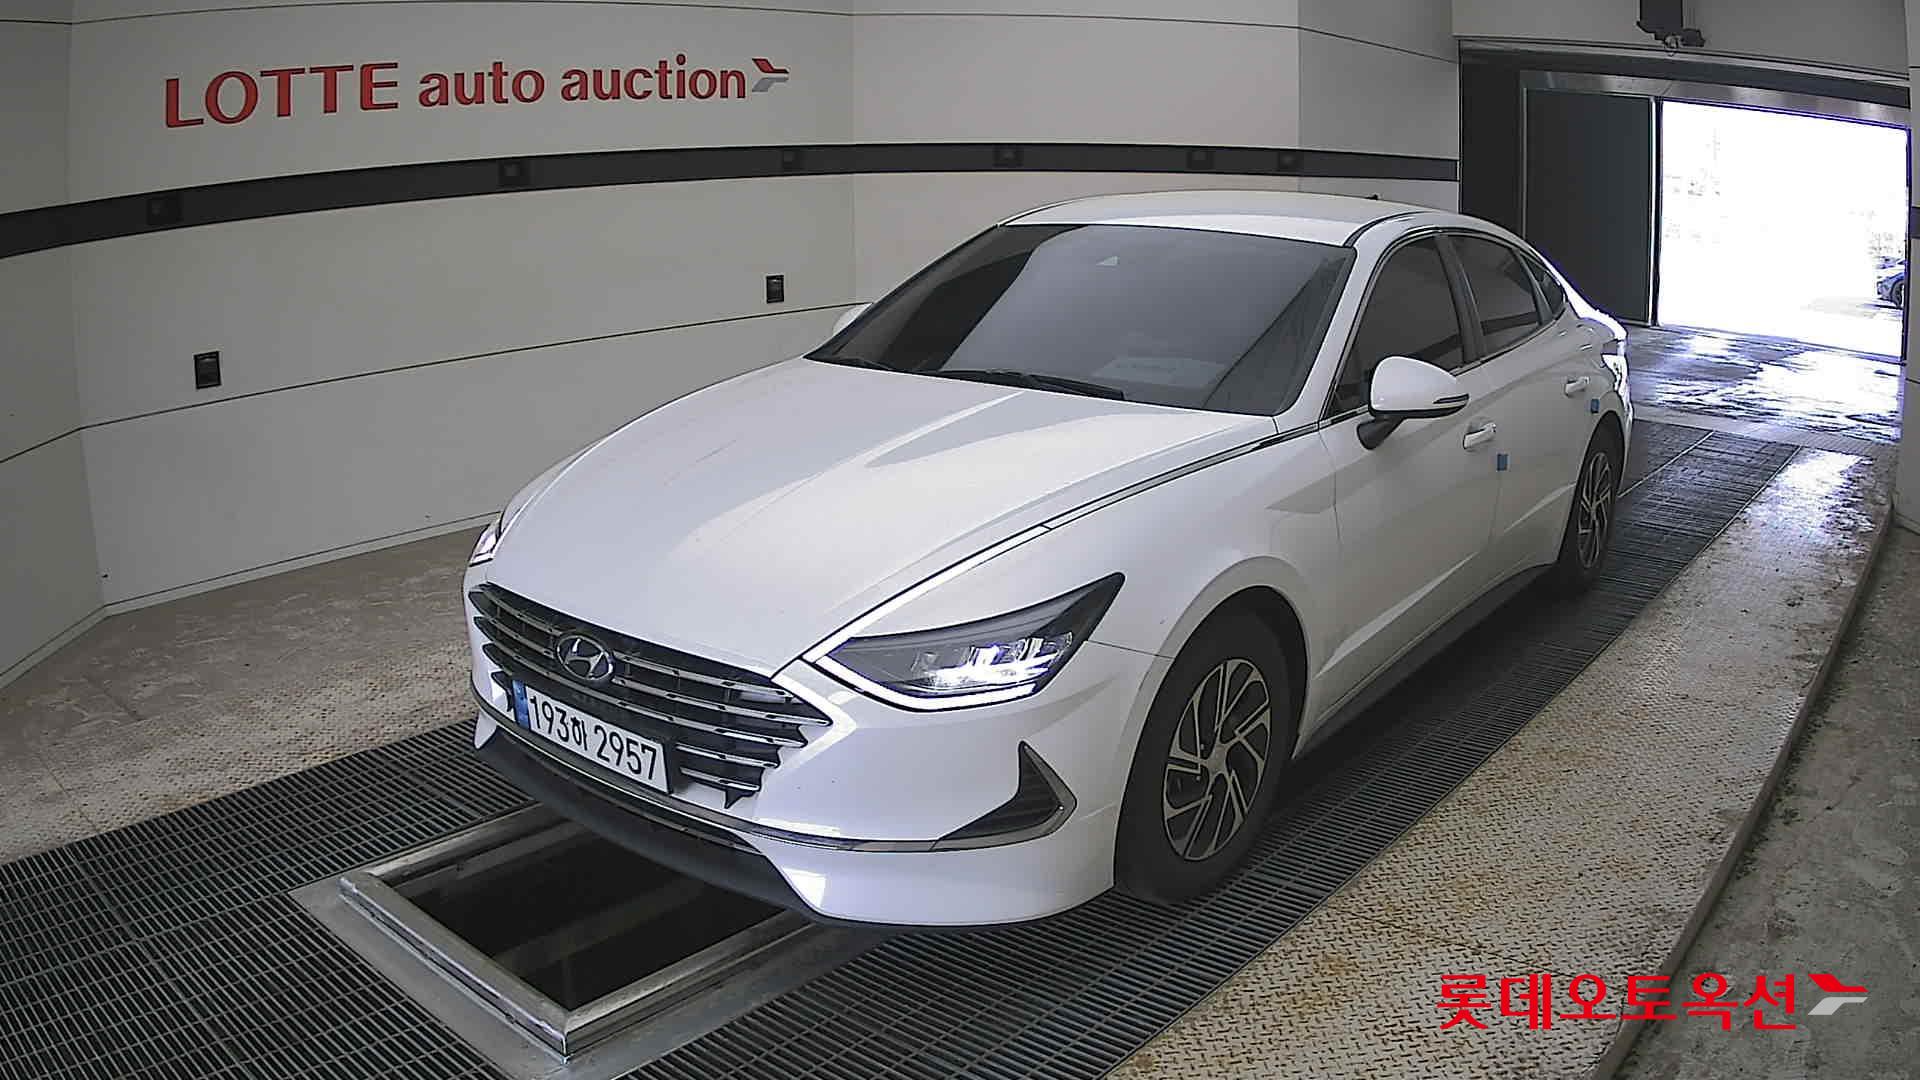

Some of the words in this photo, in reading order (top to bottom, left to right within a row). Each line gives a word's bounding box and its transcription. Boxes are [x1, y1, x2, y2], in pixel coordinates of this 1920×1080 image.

[164, 62, 400, 128] LOTTE
[418, 61, 545, 107] auto
[560, 54, 747, 101] auction
[529, 695, 588, 751] 193하
[594, 724, 657, 780] 2957
